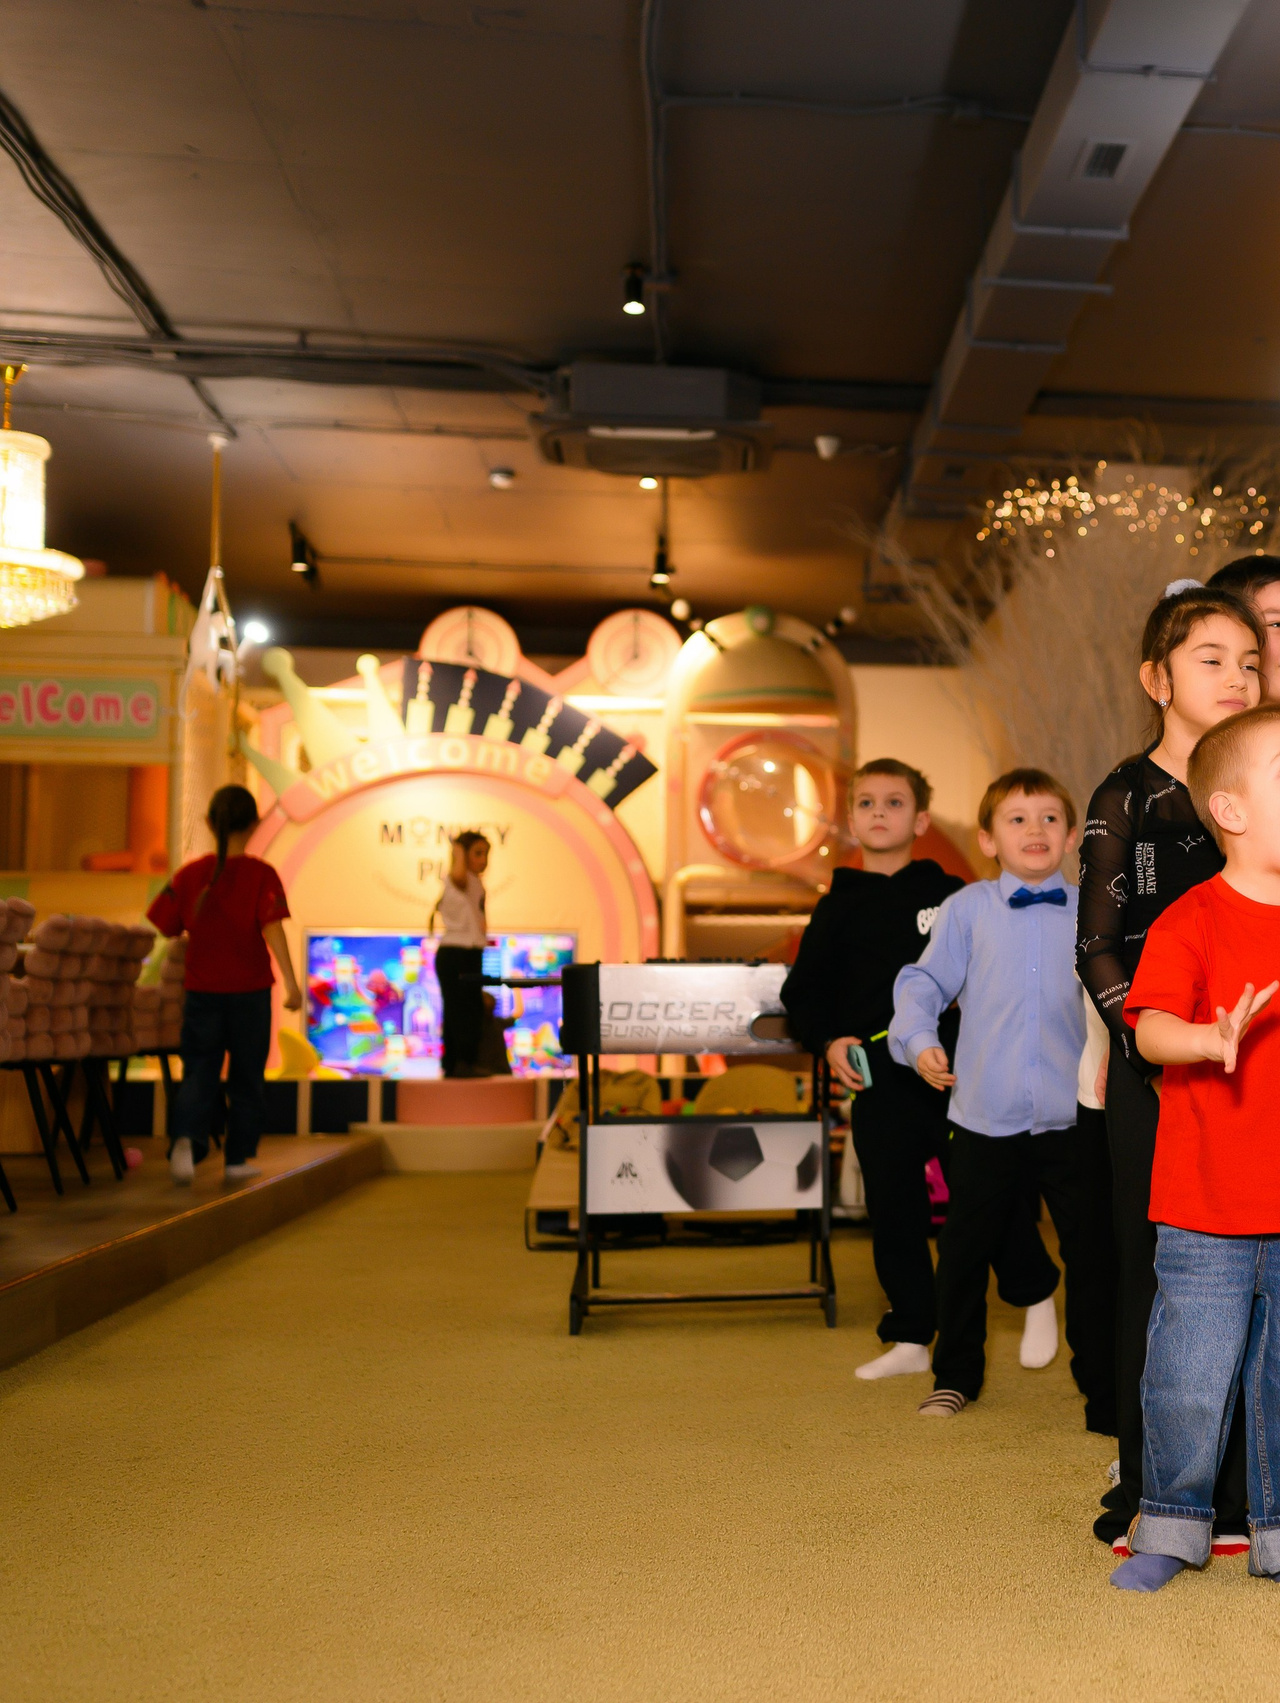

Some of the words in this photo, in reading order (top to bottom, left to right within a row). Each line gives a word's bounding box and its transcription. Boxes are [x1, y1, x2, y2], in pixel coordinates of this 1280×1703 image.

[306, 736, 552, 800] welcome
[1095, 828, 1108, 836] The
[1146, 842, 1156, 866] LET'S
[1135, 842, 1145, 895] MEMORIES
[1145, 866, 1157, 895] MAKE
[1096, 983, 1123, 1000] everyday
[600, 1001, 744, 1021] OCCER,
